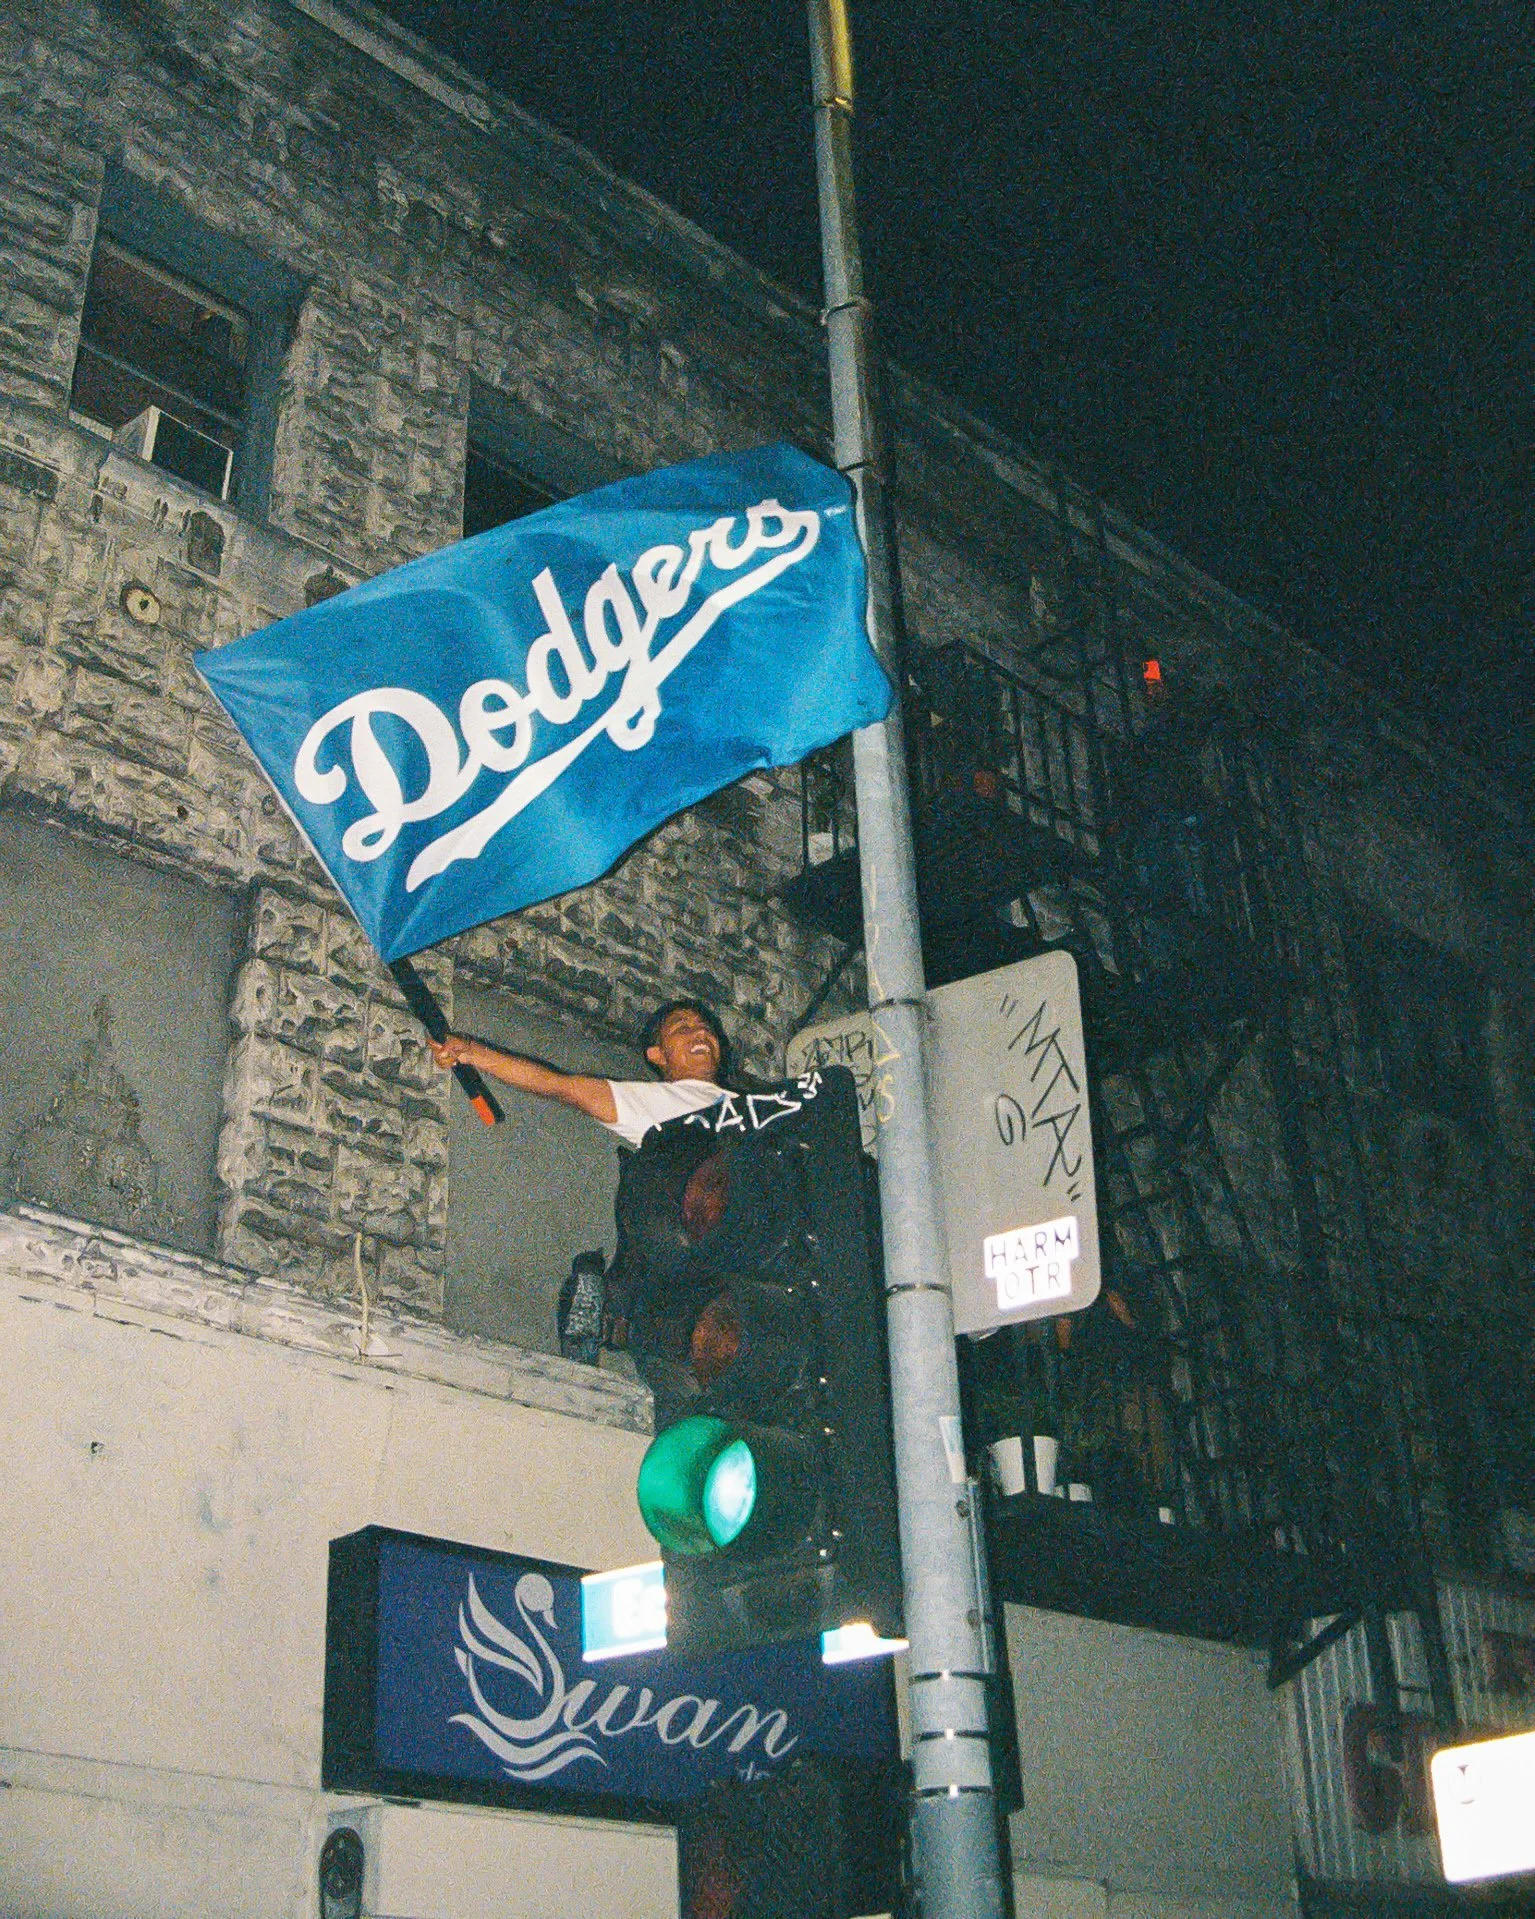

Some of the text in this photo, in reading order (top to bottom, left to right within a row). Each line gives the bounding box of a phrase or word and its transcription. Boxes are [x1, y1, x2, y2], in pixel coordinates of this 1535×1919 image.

[294, 499, 820, 893] Dodgers
[990, 1224, 1072, 1270] HARM
[1004, 1261, 1062, 1300] OTR
